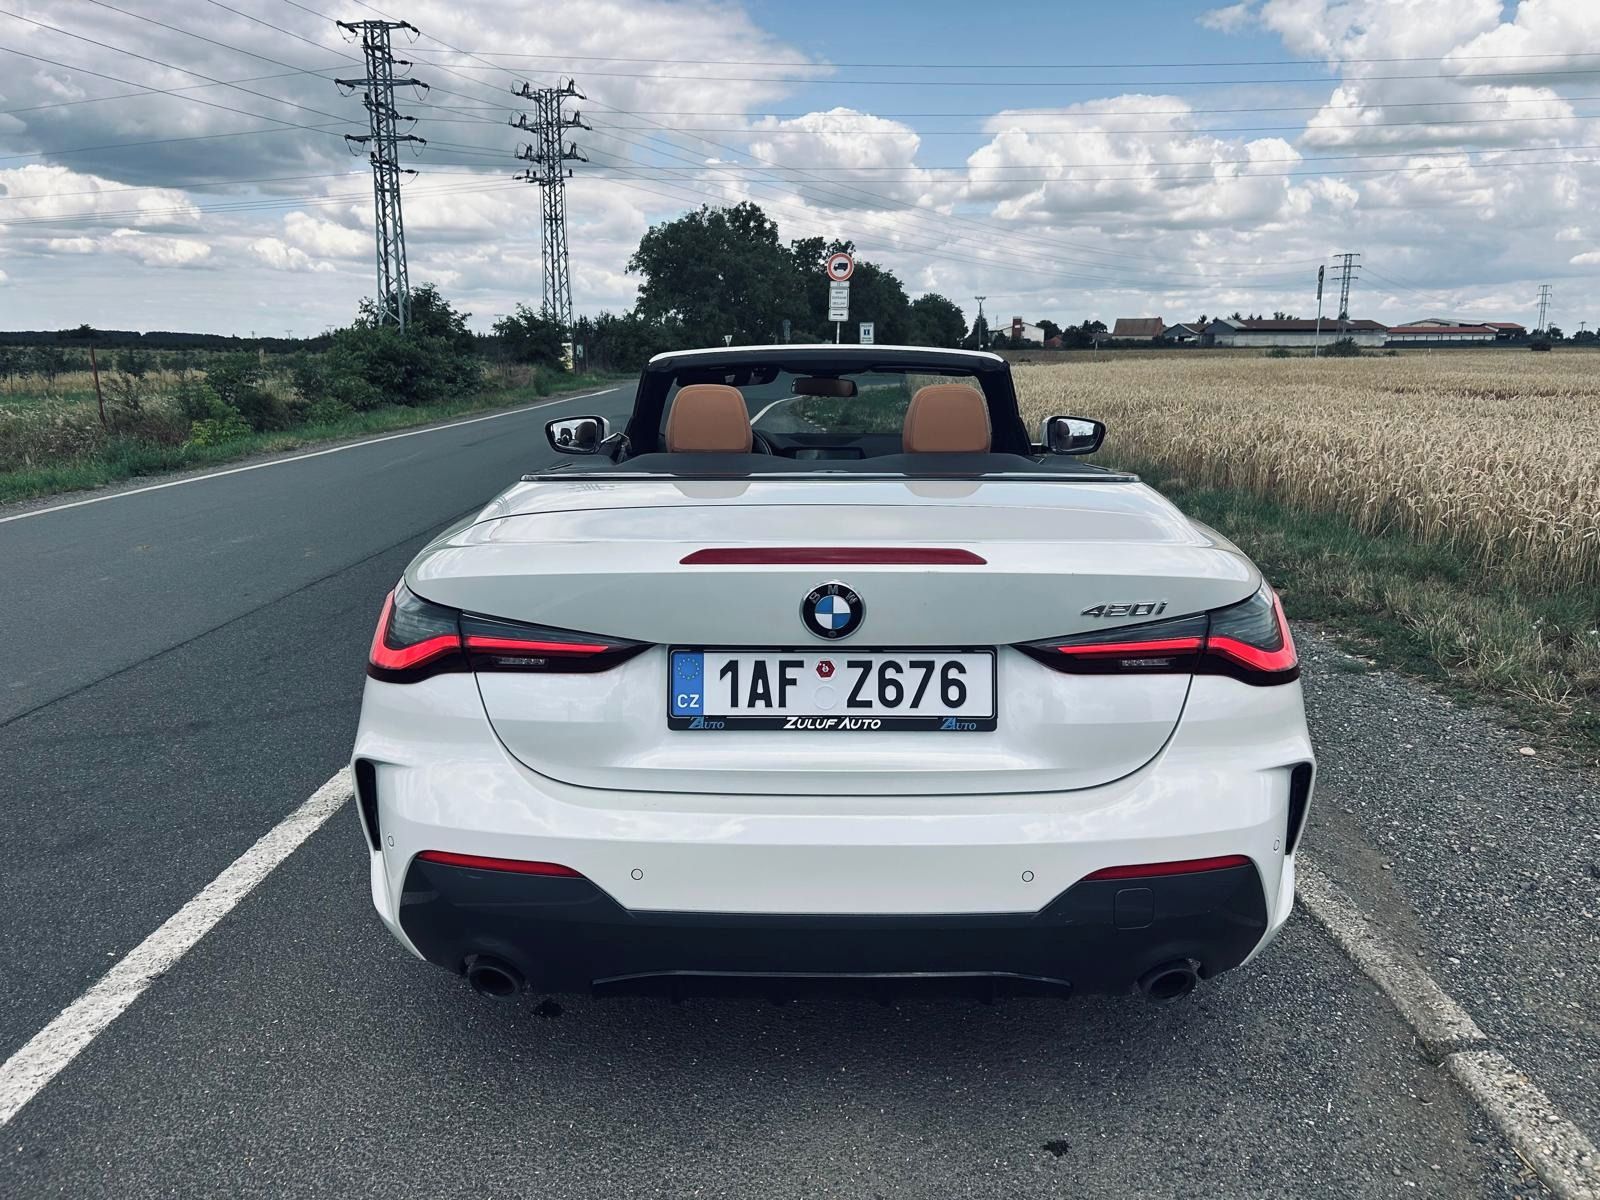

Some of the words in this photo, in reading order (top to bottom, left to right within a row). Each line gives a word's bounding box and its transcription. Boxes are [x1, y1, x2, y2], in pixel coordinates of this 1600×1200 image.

[809, 585, 858, 604] BMW
[1081, 601, 1168, 617] 420i
[720, 660, 804, 708] 1AF
[847, 660, 967, 708] Z676
[677, 694, 699, 708] CZ
[784, 716, 838, 729] ZULUF
[838, 716, 881, 729] AUTO
